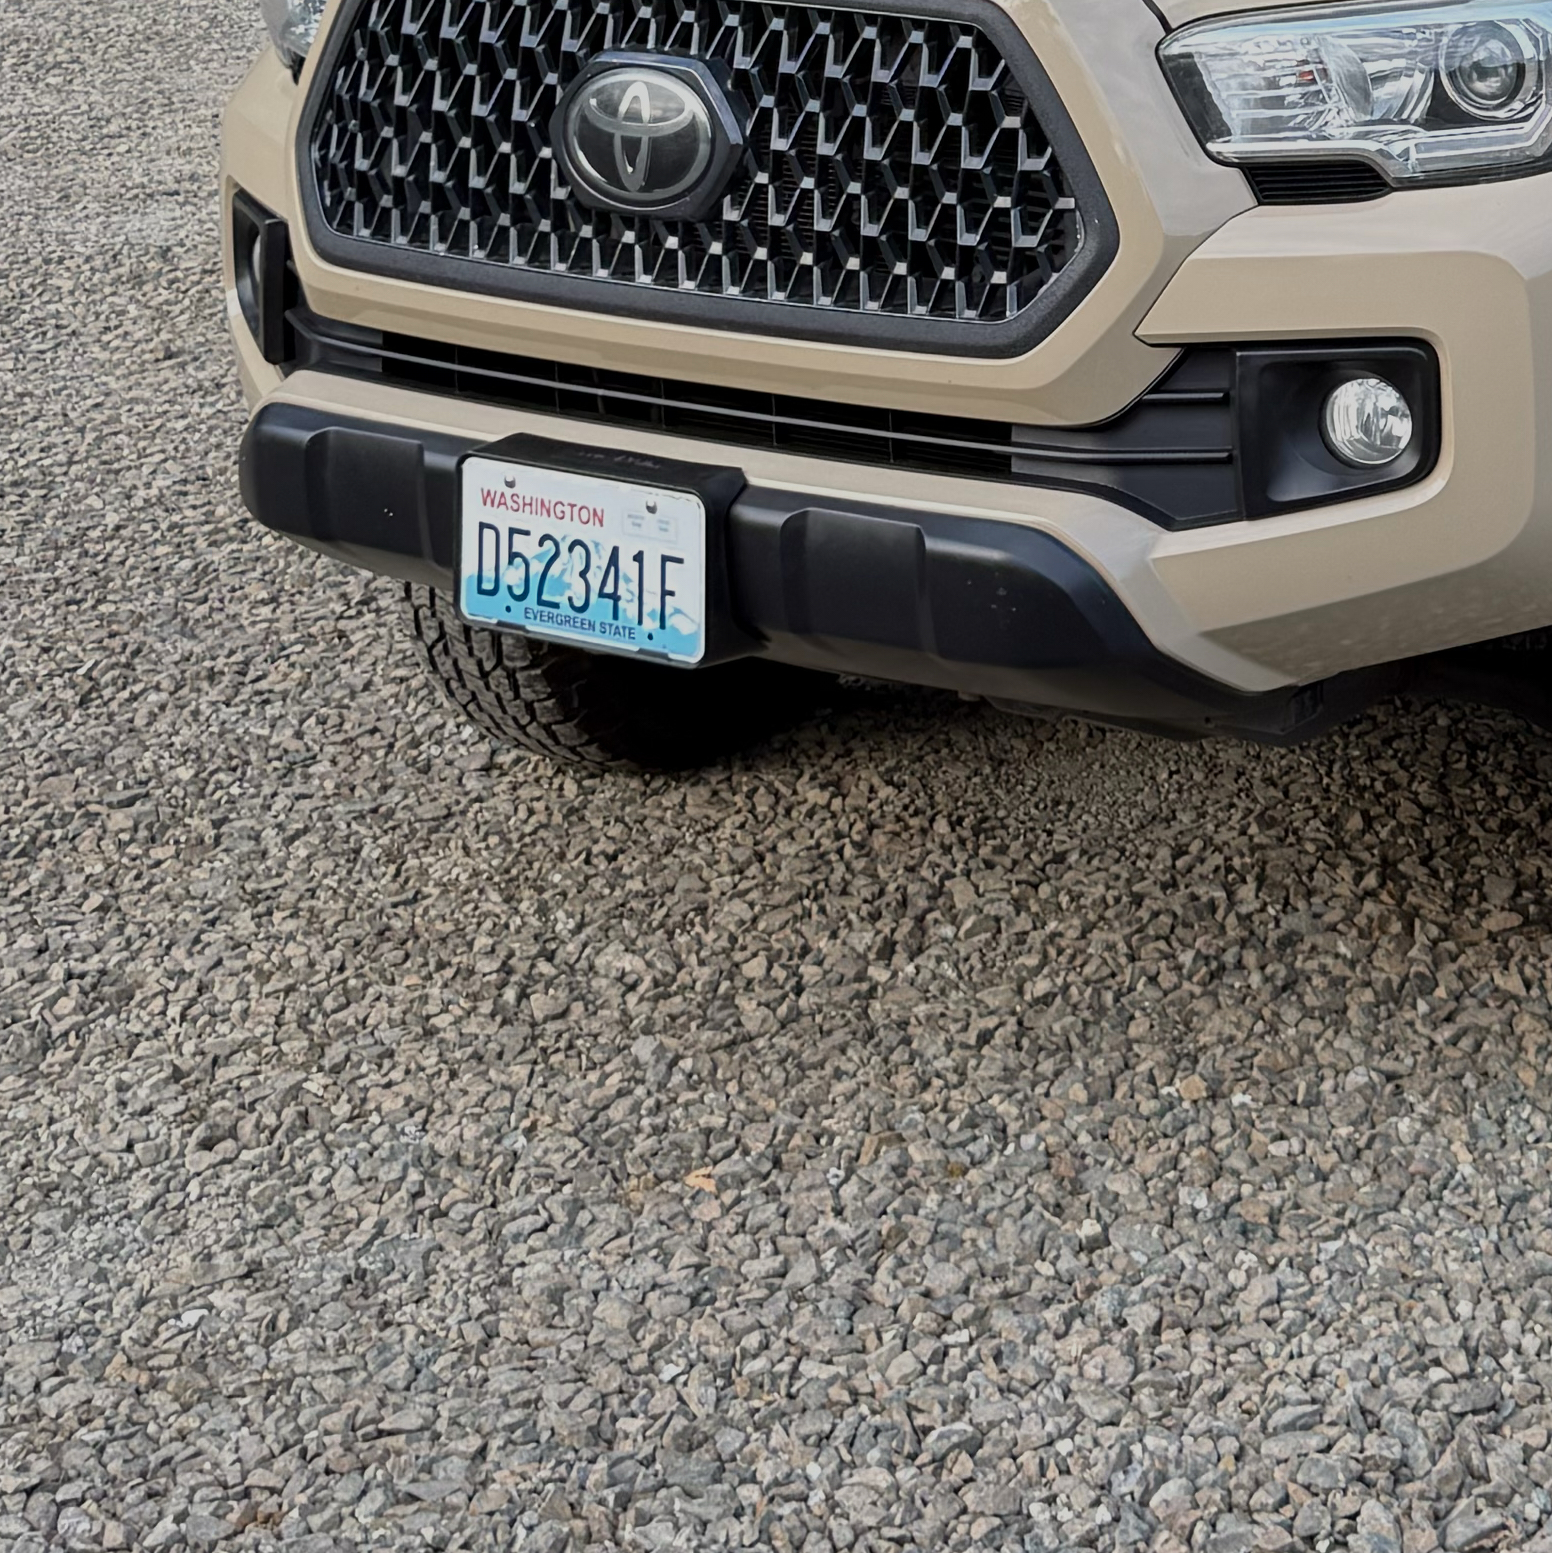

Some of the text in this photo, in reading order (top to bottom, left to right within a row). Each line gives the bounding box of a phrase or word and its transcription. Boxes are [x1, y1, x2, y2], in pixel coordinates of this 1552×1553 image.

[480, 487, 605, 528] WASHINGTON
[476, 521, 685, 630] D52341F
[523, 607, 636, 640] EVERGREEN STATE
